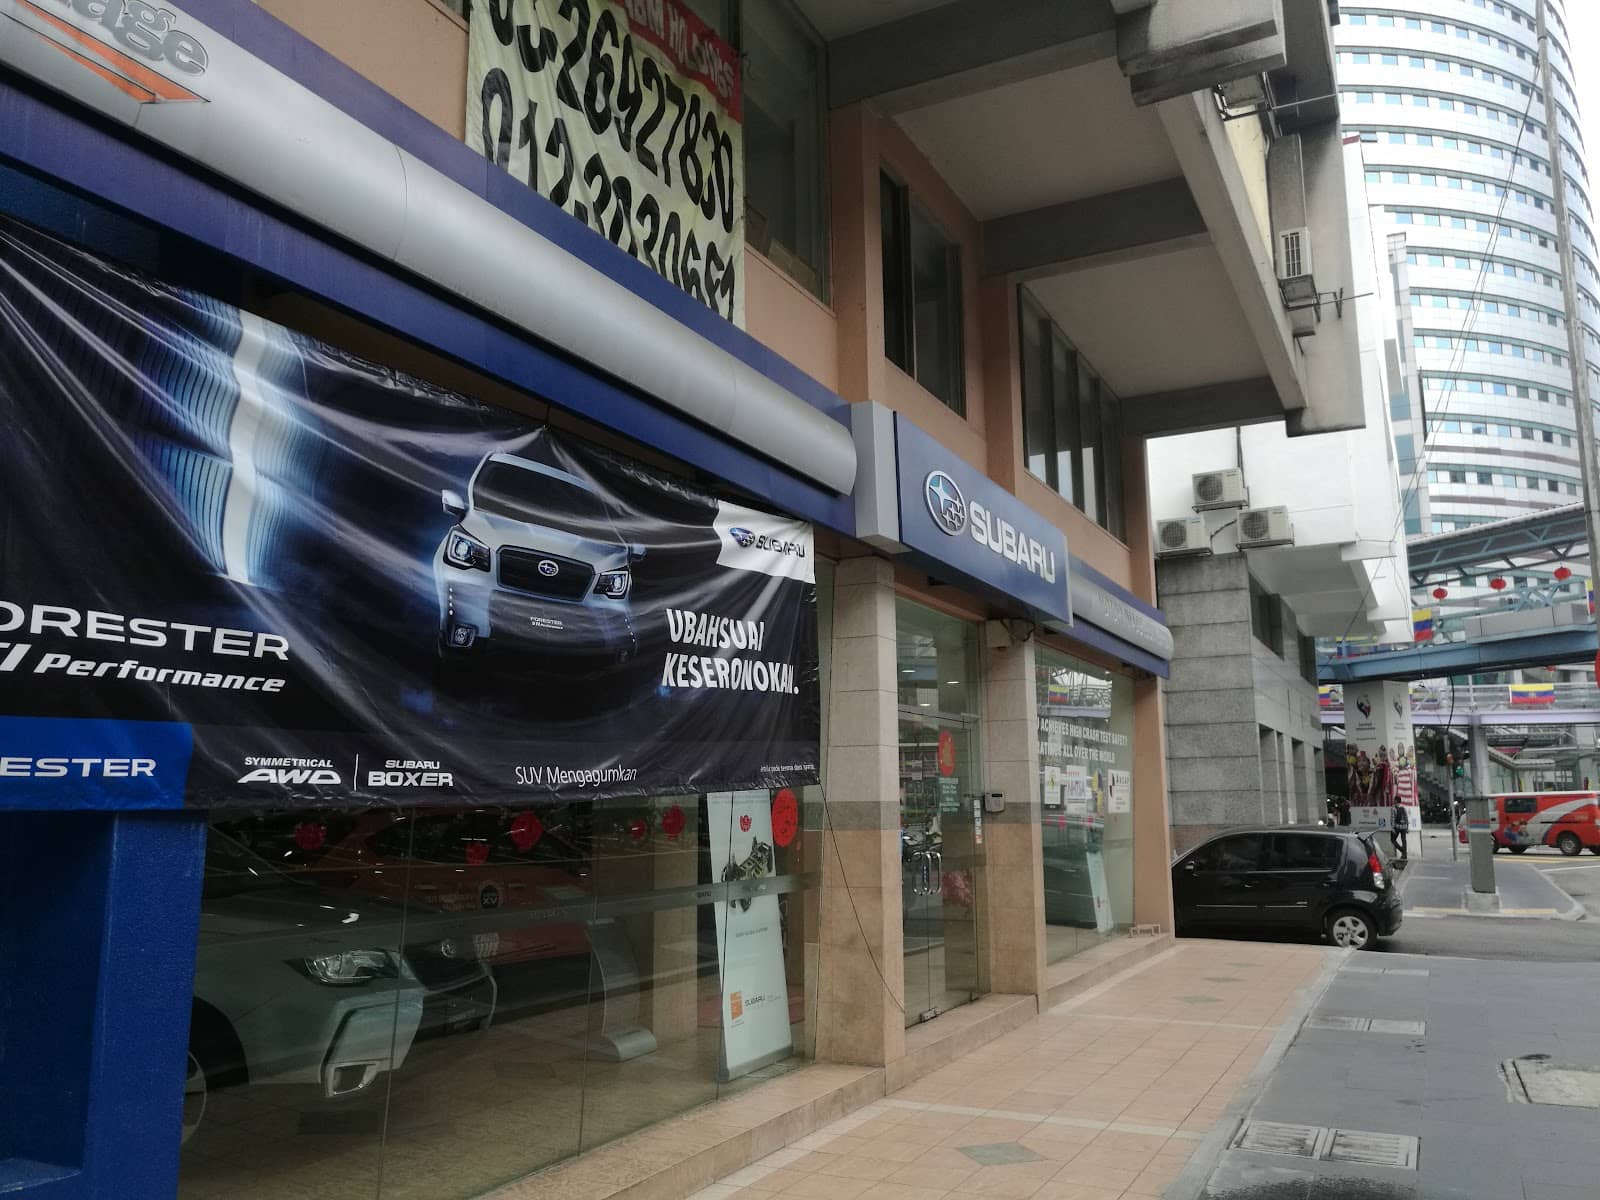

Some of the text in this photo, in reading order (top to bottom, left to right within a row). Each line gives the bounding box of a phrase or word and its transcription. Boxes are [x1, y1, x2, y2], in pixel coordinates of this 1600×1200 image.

[66, 0, 208, 77] age
[755, 534, 805, 558] SUBARU
[969, 500, 1056, 585] SUBARU
[666, 608, 766, 651] UBAHSUAI
[0, 642, 286, 693] I Performance
[661, 652, 799, 694] KESERONOKAN.
[1038, 741, 1062, 756] ATINGS
[1062, 744, 1074, 758] ALL
[0, 756, 157, 778] ESTER
[244, 757, 334, 768] SYMMETRICAL
[385, 759, 440, 770] SUBARU
[237, 768, 342, 785] AWD
[367, 771, 454, 787] BOXER
[515, 763, 638, 788] SUV Mengagumkan
